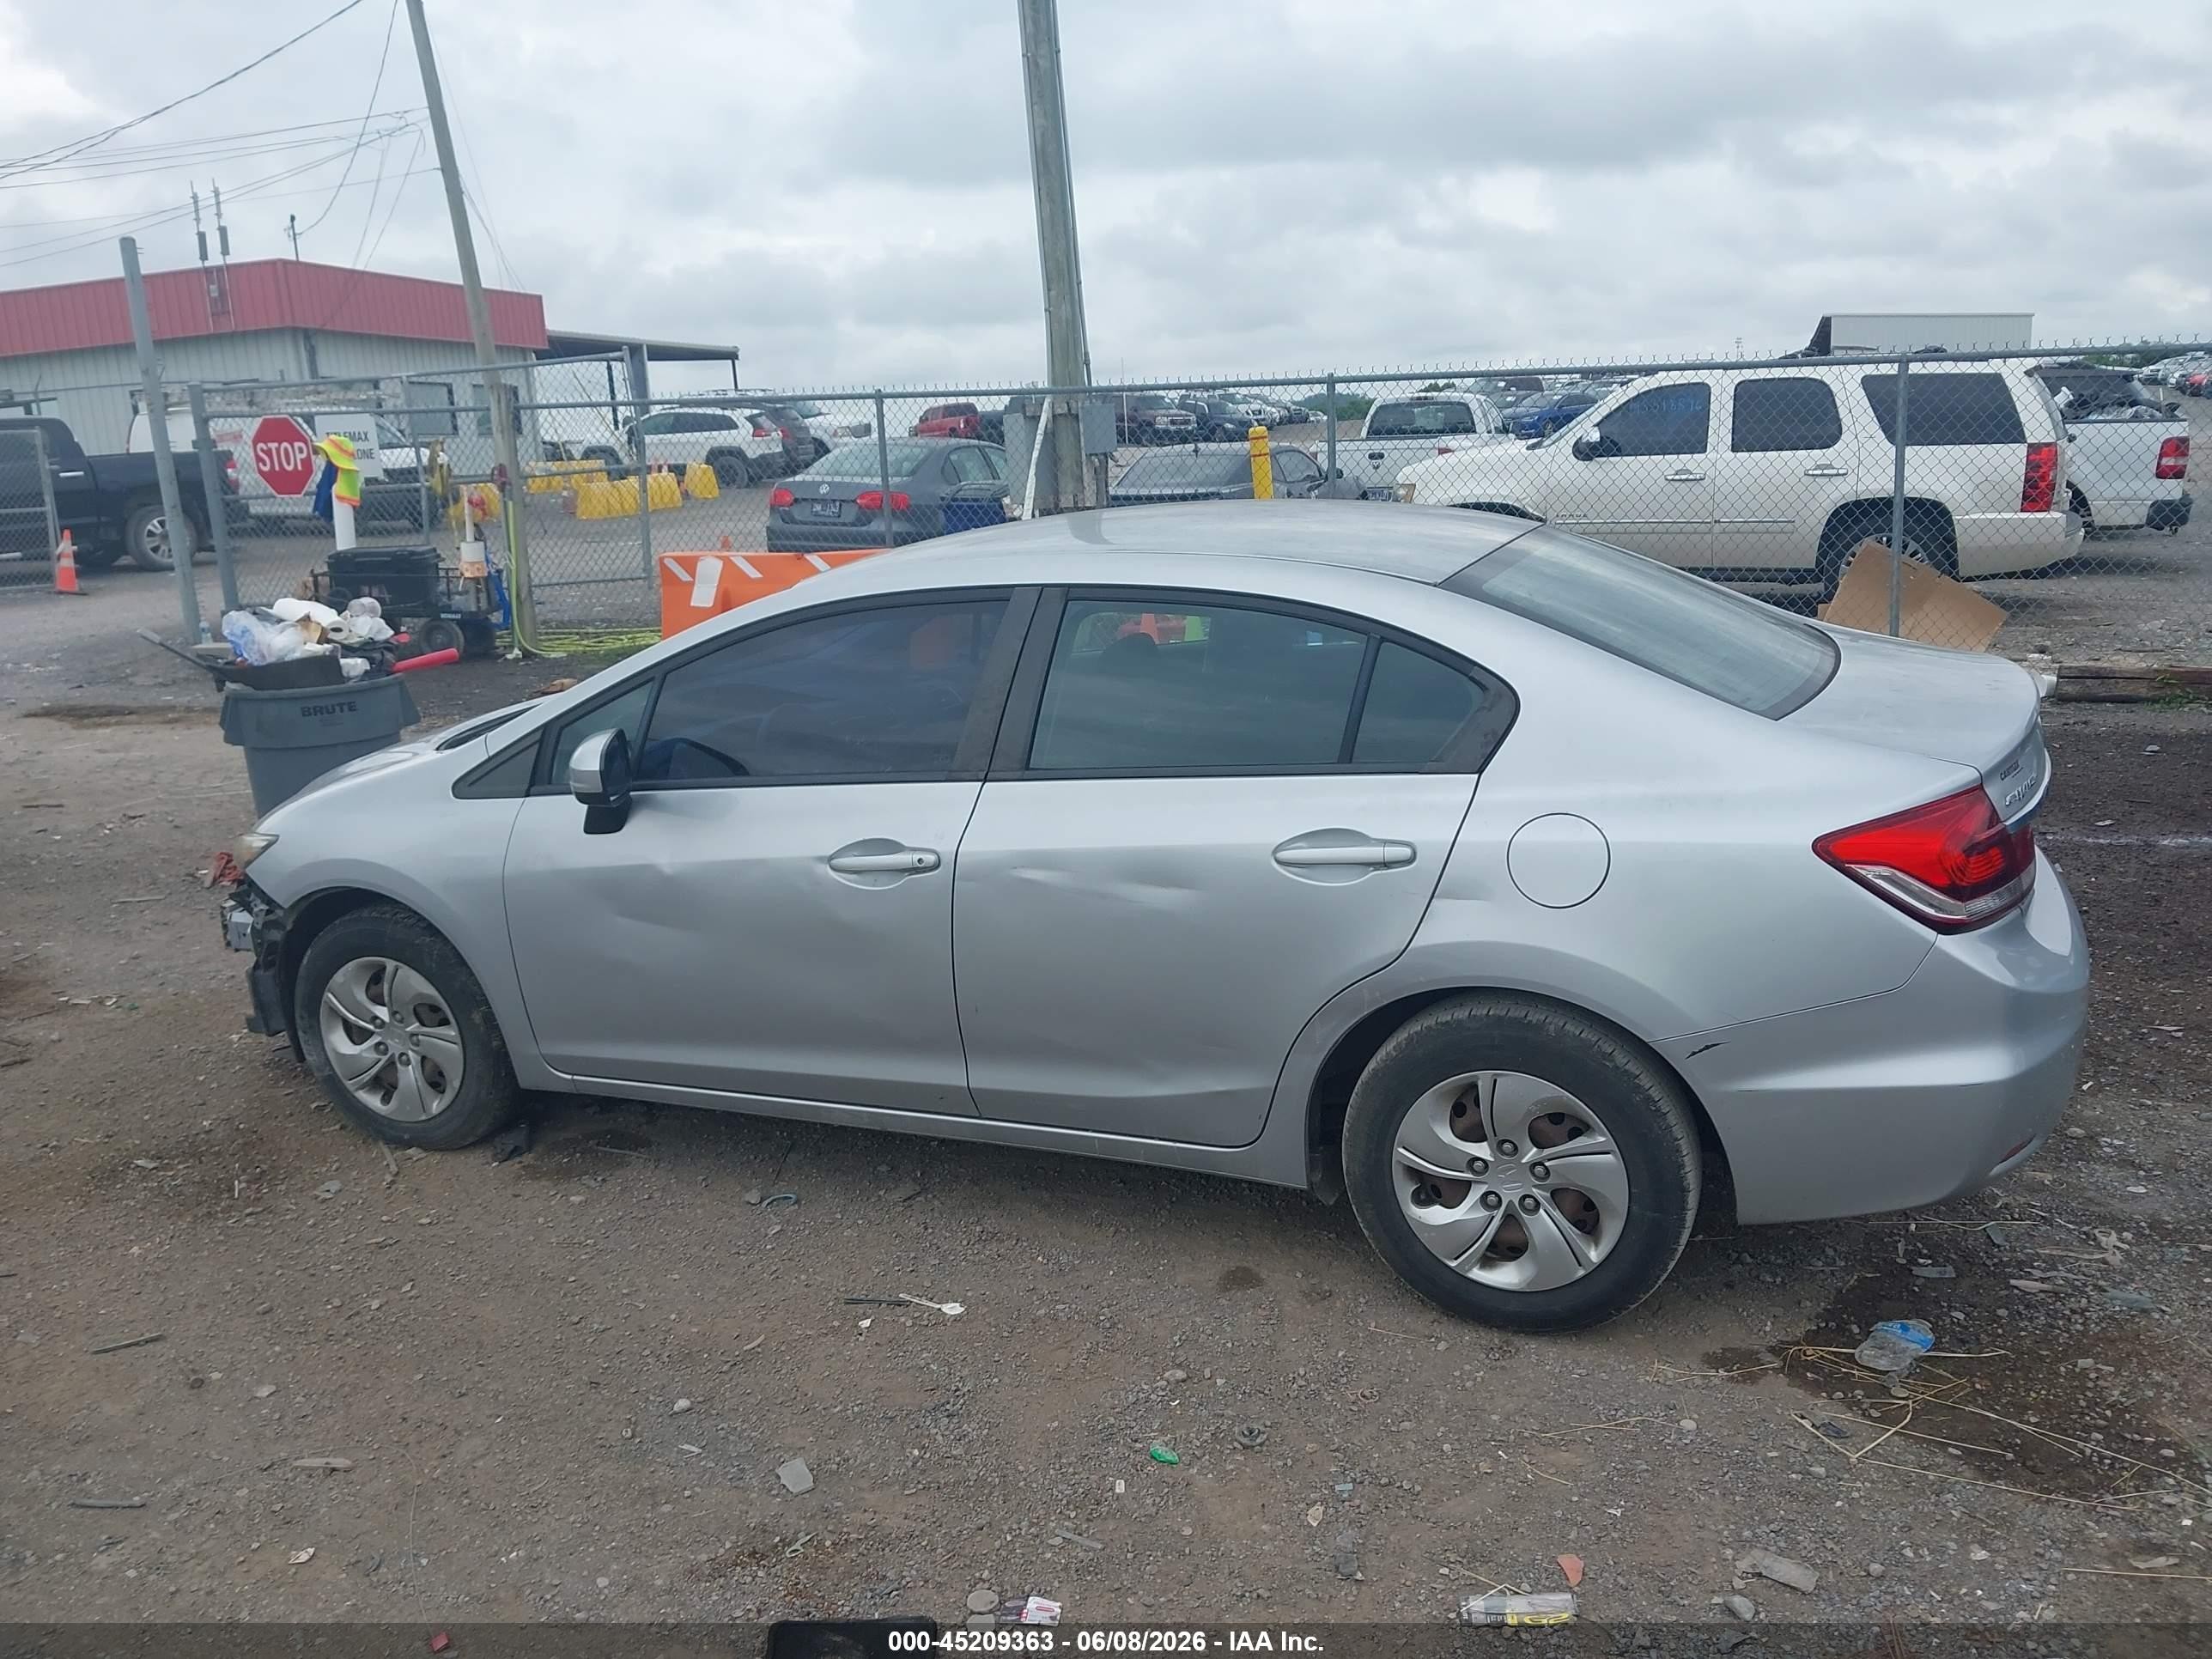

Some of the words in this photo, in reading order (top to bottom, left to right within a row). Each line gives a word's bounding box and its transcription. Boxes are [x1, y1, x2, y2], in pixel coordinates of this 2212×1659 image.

[325, 430, 369, 443] TEMAX
[257, 441, 307, 471] STOP
[353, 448, 375, 460] ONE
[301, 701, 357, 718] BRUTE
